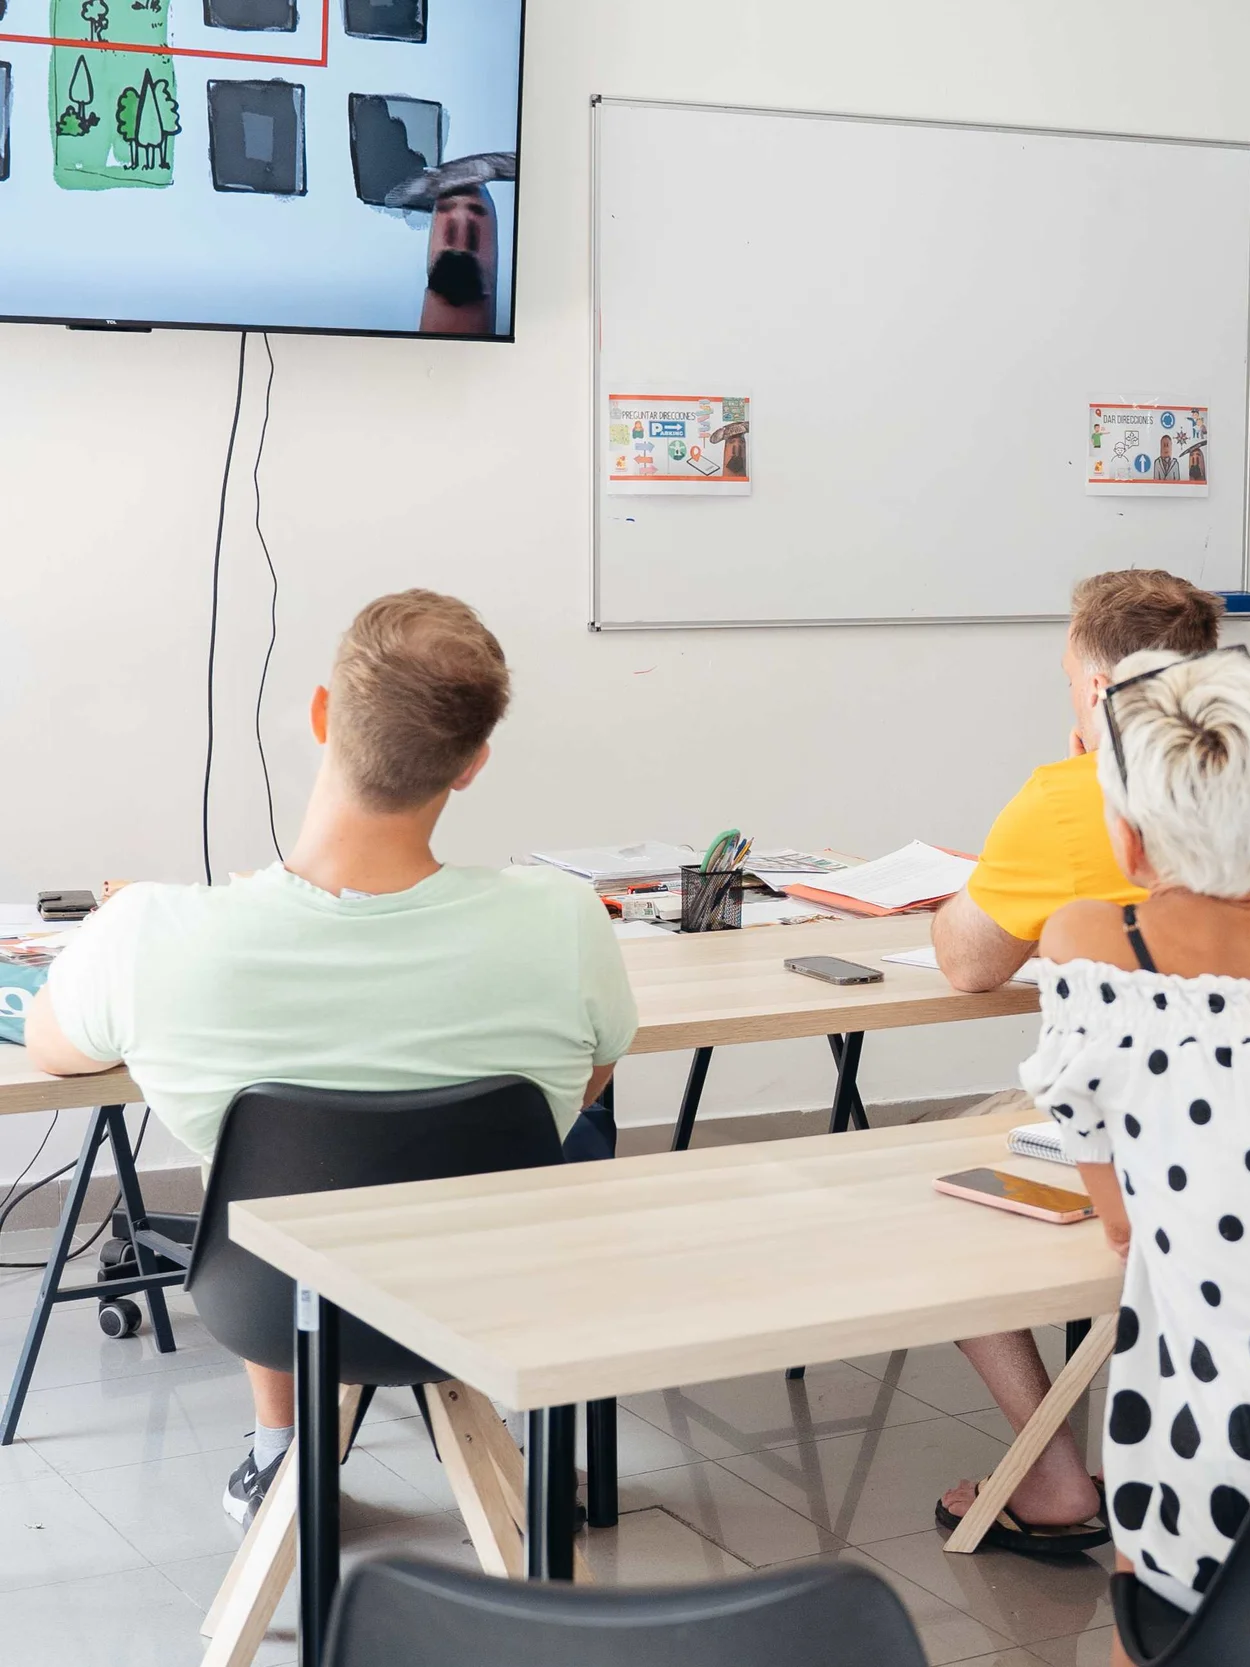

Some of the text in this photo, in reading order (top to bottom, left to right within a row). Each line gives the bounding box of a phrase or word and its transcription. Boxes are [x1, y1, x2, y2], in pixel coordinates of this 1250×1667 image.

[621, 410, 696, 420] PREGUNTAR DIRECCIONES
[1103, 414, 1116, 424] DAR
